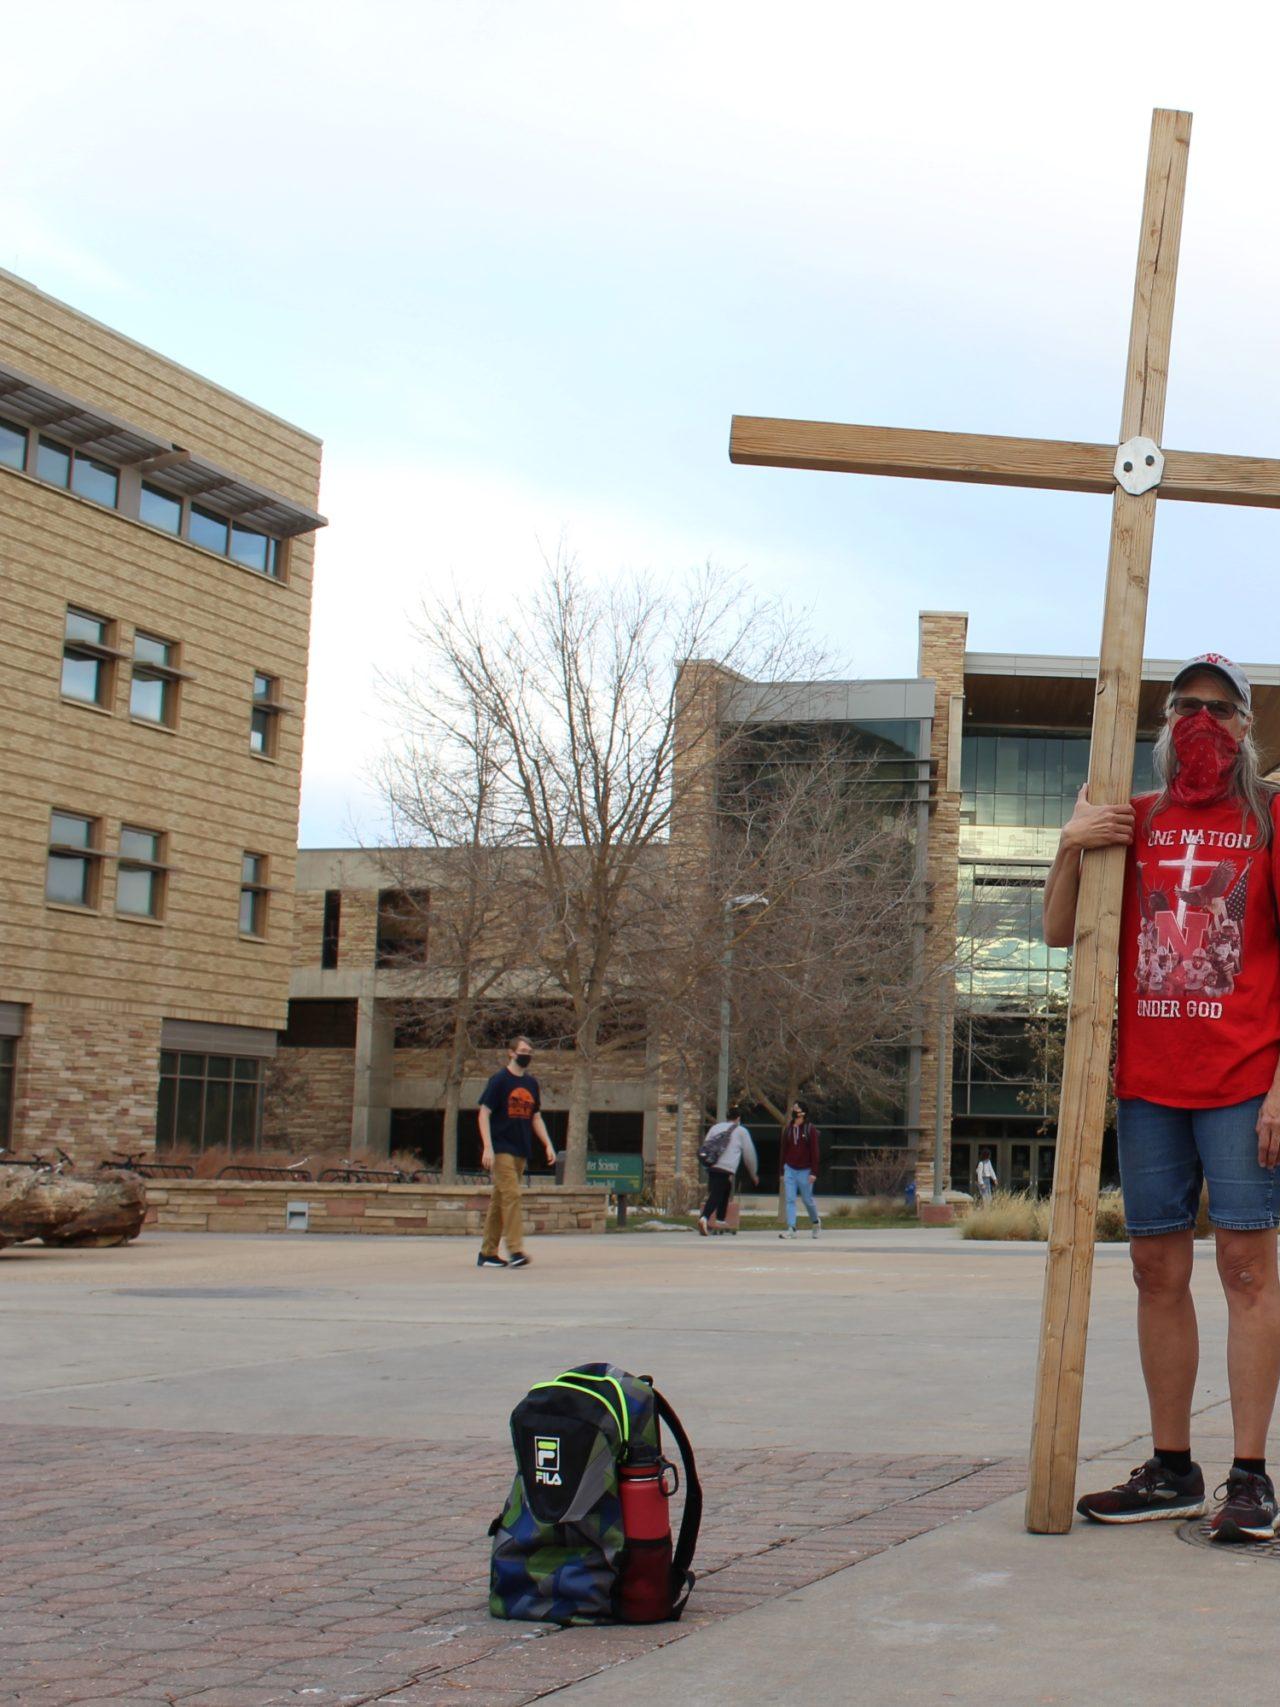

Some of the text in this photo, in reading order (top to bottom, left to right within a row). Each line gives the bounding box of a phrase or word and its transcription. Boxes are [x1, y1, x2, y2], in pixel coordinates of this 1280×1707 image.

[1180, 828, 1253, 849] NATION
[1136, 999, 1223, 1019] UNDER GOD
[535, 1470, 562, 1486] FILA
